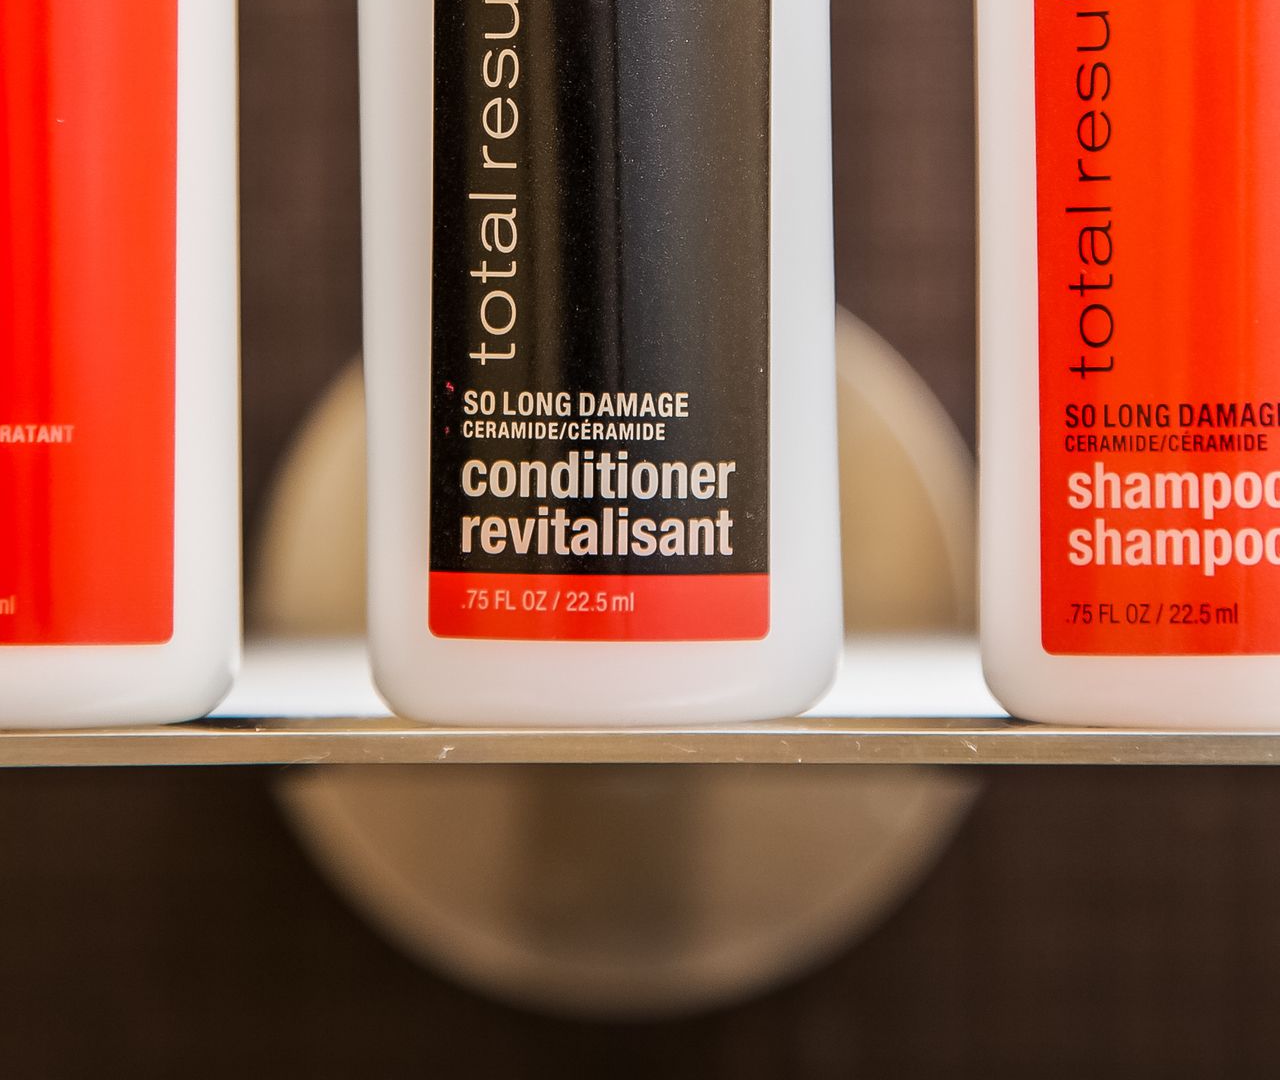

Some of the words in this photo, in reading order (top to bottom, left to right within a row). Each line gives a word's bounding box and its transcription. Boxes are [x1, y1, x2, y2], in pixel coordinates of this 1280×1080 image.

[468, 191, 517, 366] total
[1065, 206, 1114, 379] total
[463, 390, 496, 416] SO
[503, 391, 571, 417] LONG
[579, 392, 689, 418] DAMAGE
[1065, 404, 1096, 428] SO
[1104, 403, 1170, 428] LONG
[463, 419, 666, 441] CERAMIDE/CÉRAMIDE
[1065, 432, 1268, 453] CERAMIDE/CÉRAMIDE
[461, 450, 736, 500] conditioner
[461, 506, 734, 557] revitalisant
[461, 589, 489, 611] .75
[494, 590, 516, 610] FL
[522, 590, 547, 612] OZ
[566, 591, 608, 612] 22.5
[612, 591, 635, 612] ml
[1066, 603, 1092, 624] .75
[1099, 603, 1120, 624] FL
[1126, 603, 1151, 624] OZ
[1169, 603, 1211, 624] 22.5
[1215, 602, 1238, 624] ml
